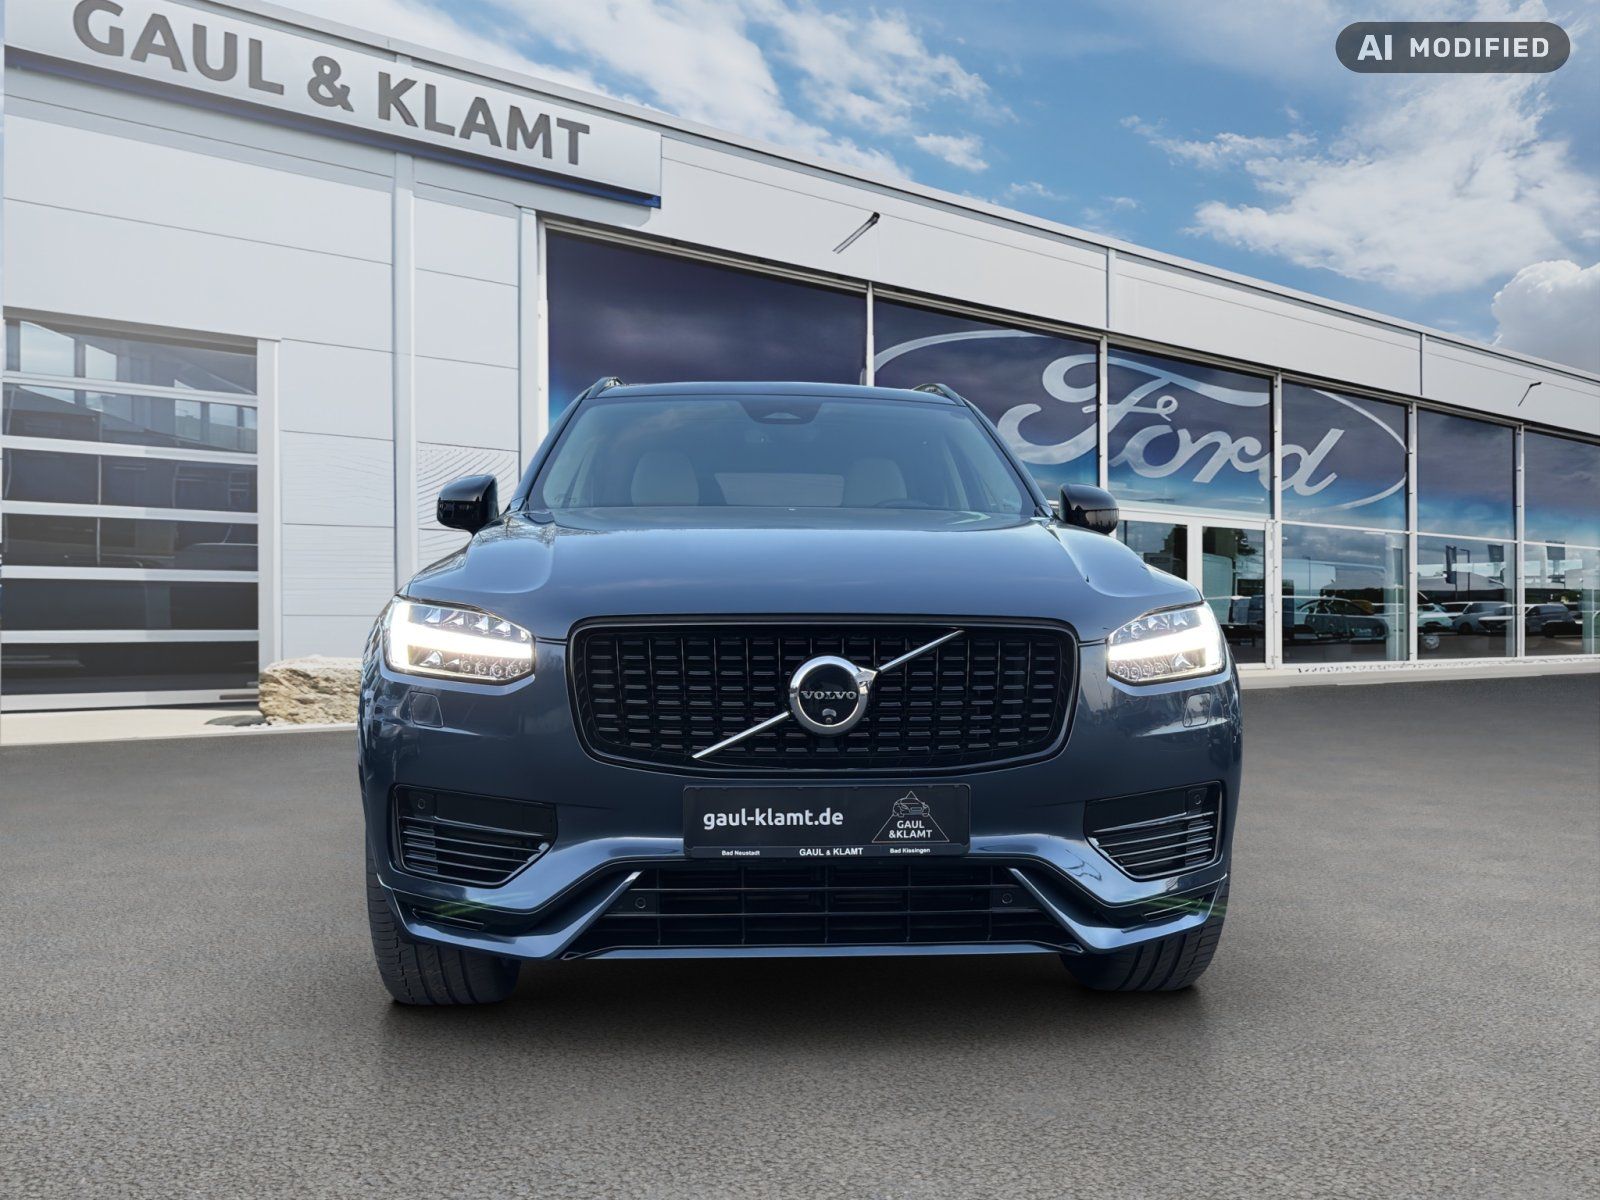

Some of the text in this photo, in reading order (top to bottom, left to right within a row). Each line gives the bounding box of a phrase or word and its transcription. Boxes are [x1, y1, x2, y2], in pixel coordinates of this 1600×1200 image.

[73, 0, 590, 166] GAUL & KLAMT
[998, 353, 1345, 496] Ford
[800, 690, 857, 700] VOLVO
[703, 807, 844, 830] gaul-klamt.de
[896, 820, 925, 829] GAUL
[888, 829, 933, 839] &KLAMT
[799, 848, 824, 856] GAUL
[833, 847, 864, 856] KLAMT
[902, 847, 931, 855] Kissingen
